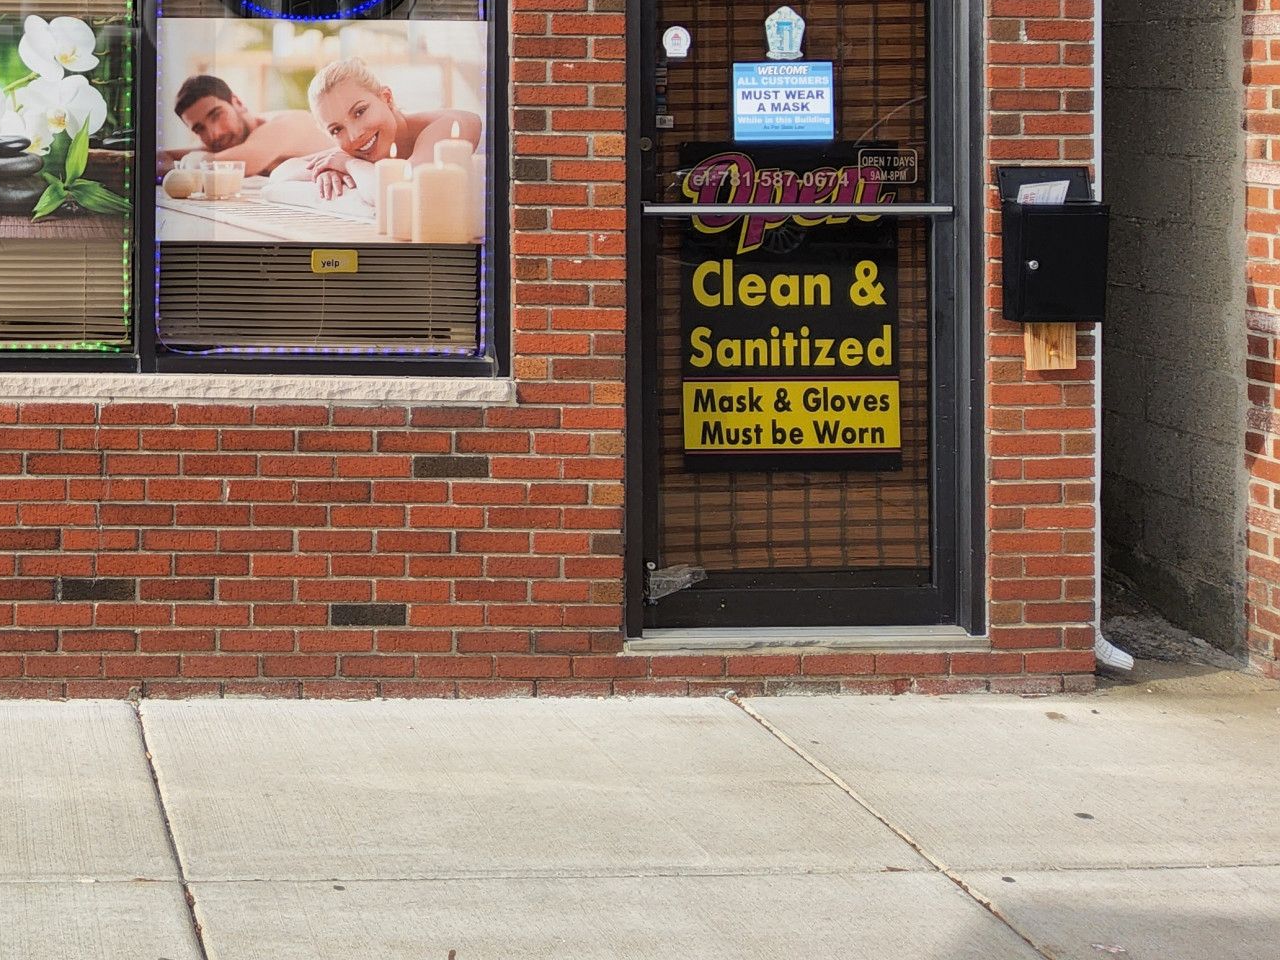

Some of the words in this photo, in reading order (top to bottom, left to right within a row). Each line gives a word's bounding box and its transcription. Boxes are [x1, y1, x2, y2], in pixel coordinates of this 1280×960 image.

[756, 65, 810, 76] WELCOME
[737, 76, 759, 85] ALL
[761, 76, 830, 85] CUSTOMERS
[741, 90, 781, 100] MUST
[785, 89, 825, 100] WEAR
[757, 102, 766, 112] A
[771, 102, 810, 112] MASK
[738, 116, 762, 124] While
[764, 116, 774, 124] in
[776, 116, 792, 124] this
[794, 116, 830, 125] Building
[862, 156, 885, 167] OPEN
[886, 156, 892, 167] 7
[893, 156, 915, 167] DAYS
[870, 170, 907, 181] 9AM-8PM
[682, 151, 896, 255] Open
[321, 259, 340, 268] yelp
[691, 259, 832, 308] Clean
[850, 259, 888, 307] &
[689, 324, 894, 368] Sanitized
[693, 387, 763, 414] Mask
[773, 388, 793, 414] &
[802, 386, 892, 414] Gloves
[700, 420, 764, 446] Must
[771, 419, 804, 446] be
[812, 419, 886, 445] Worn
